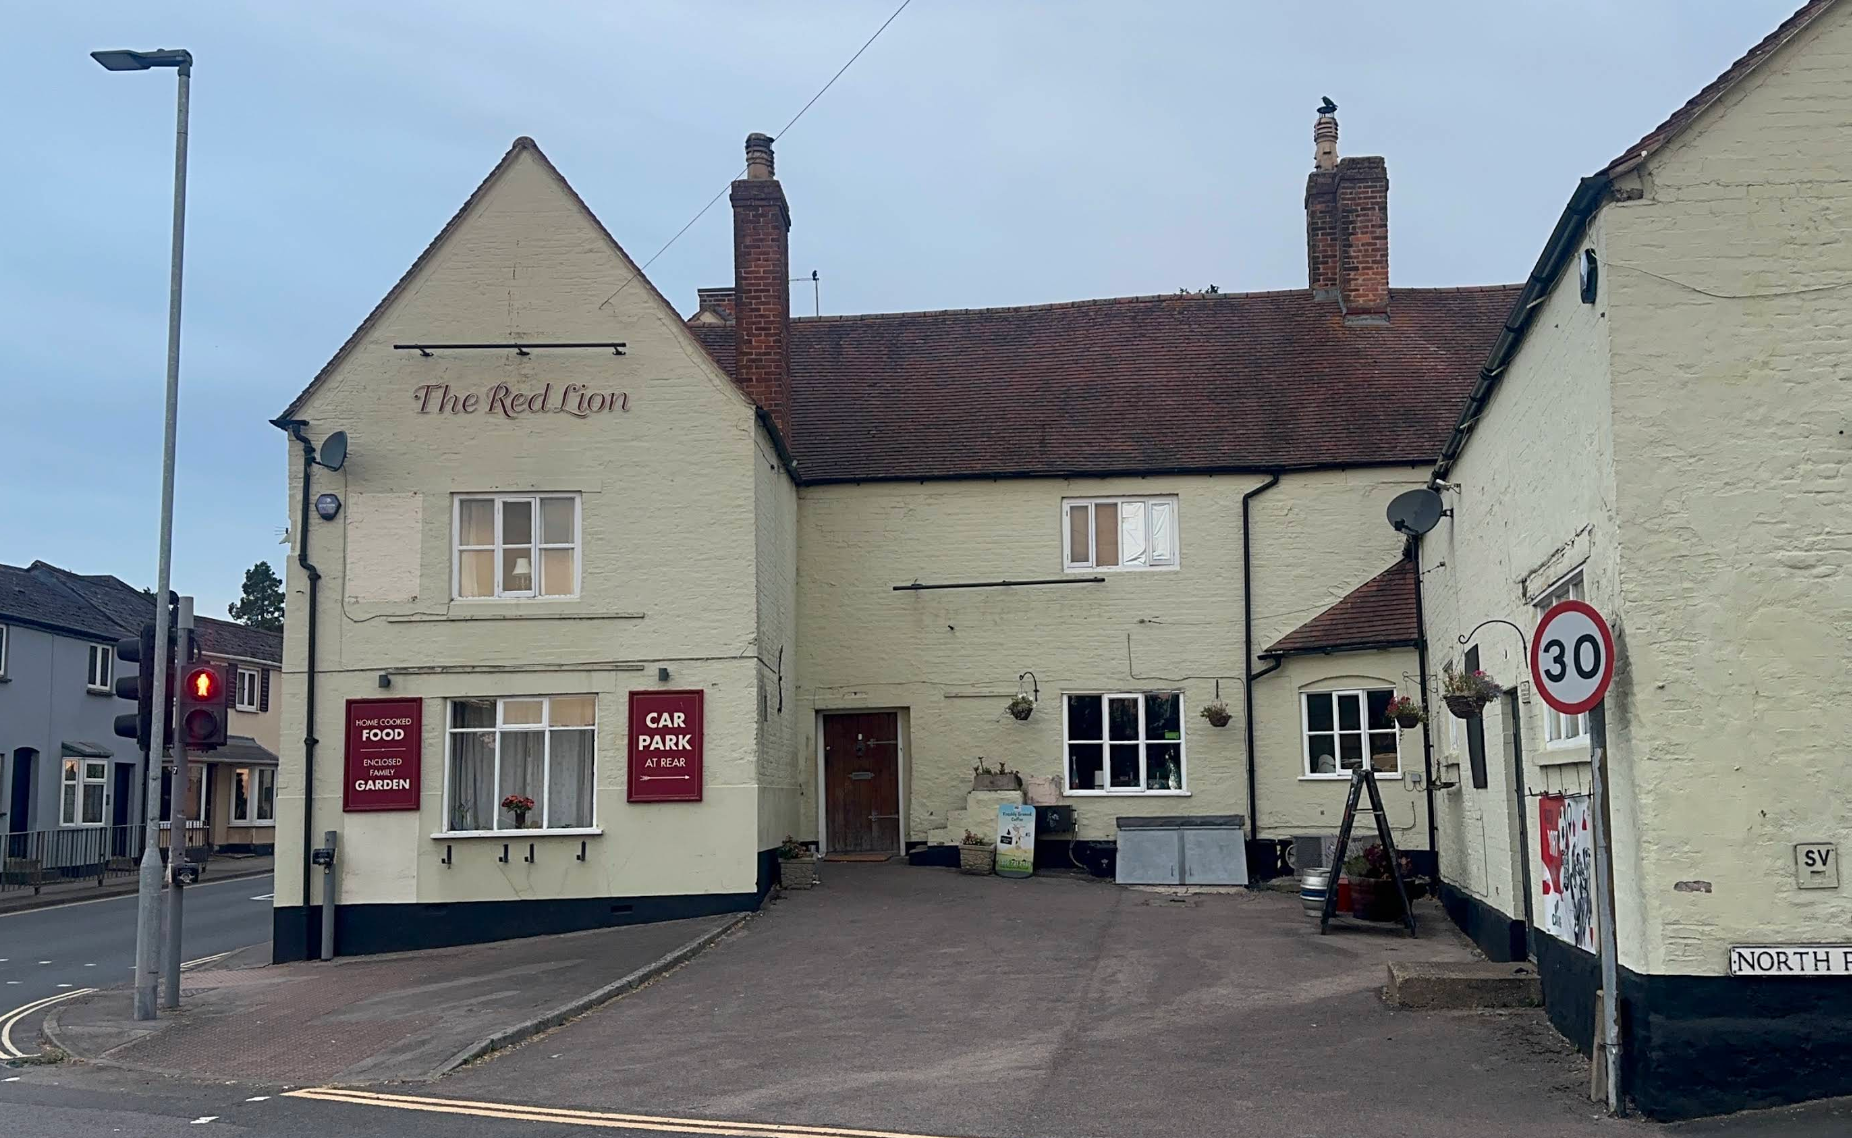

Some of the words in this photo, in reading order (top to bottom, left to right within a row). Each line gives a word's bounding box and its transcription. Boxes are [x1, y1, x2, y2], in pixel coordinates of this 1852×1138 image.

[413, 383, 479, 414] The
[485, 381, 552, 419] Red
[553, 383, 629, 419] Lion
[1543, 633, 1602, 683] 30
[379, 718, 411, 726] COOKED
[645, 712, 686, 728] CAR
[362, 729, 404, 741] FOOD
[638, 734, 692, 750] PARK
[363, 758, 402, 766] ENCLOSED
[644, 758, 658, 767] AT
[660, 758, 686, 767] REAR
[355, 779, 410, 790] GARDEN
[1804, 849, 1831, 867] SV
[1736, 951, 1831, 972] NORTH
